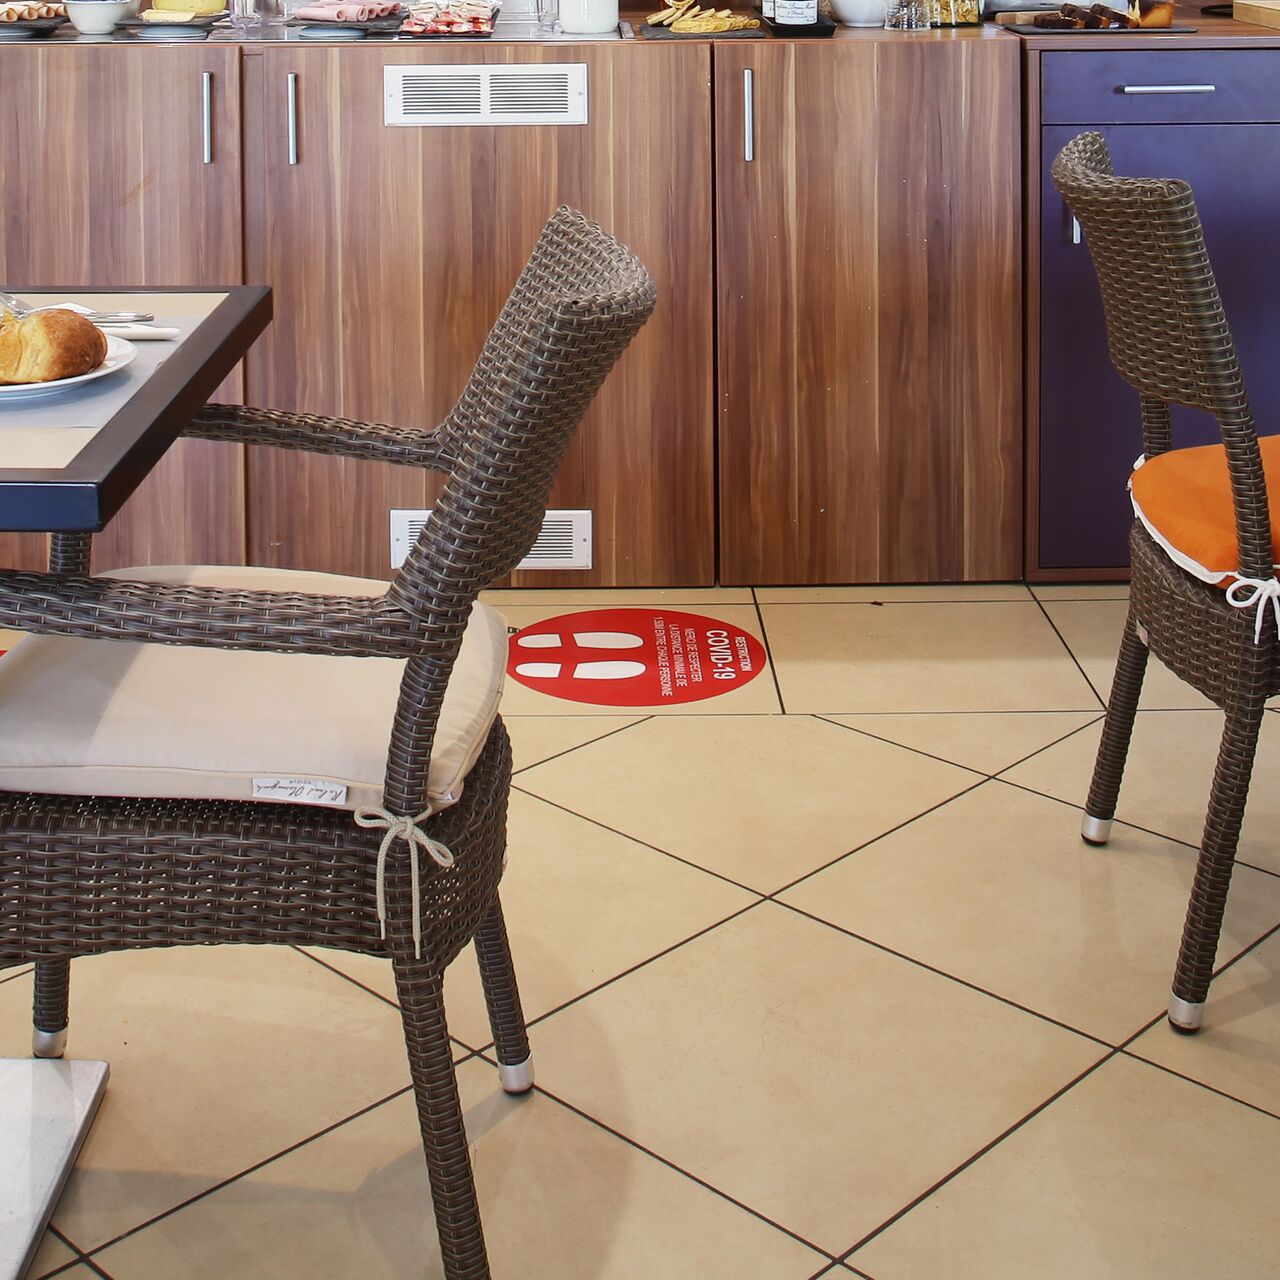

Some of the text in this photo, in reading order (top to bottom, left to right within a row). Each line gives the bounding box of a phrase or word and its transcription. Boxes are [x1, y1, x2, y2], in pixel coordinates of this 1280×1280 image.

[655, 630, 667, 645] ENTRE
[670, 631, 683, 654] DISTANCE
[685, 628, 696, 643] MERCI
[657, 646, 669, 667] CHAQUE
[706, 629, 736, 679] COVID-19
[734, 636, 753, 671] RESTRICTION
[673, 654, 687, 679] MINIMALE
[688, 652, 703, 682] RESPECTER
[659, 667, 673, 696] PERSONNE
[676, 679, 688, 687] DE
